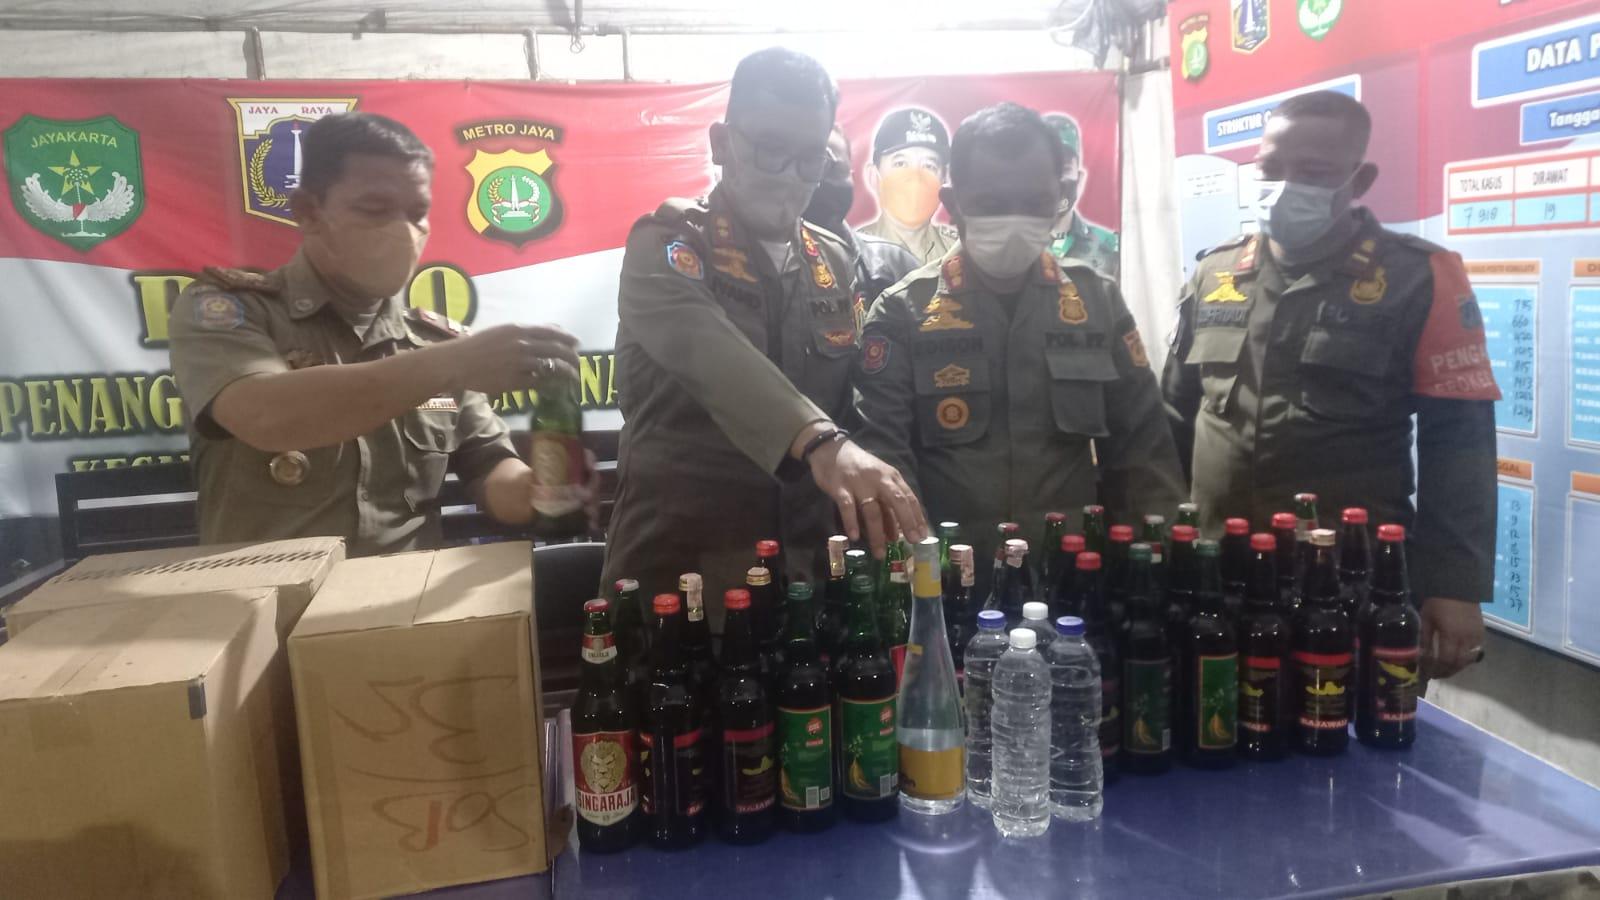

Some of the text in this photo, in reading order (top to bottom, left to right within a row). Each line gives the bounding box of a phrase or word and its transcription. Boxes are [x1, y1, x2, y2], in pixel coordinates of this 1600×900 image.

[1526, 38, 1582, 73] DATA
[249, 106, 333, 115] JAYA RAYA
[463, 123, 555, 141] METRO JAYA
[1217, 113, 1263, 137] STRUKTUR
[31, 131, 118, 148] JAYAKARTA
[1460, 175, 1502, 192] TOTAL KASUS
[1533, 168, 1569, 186] DIRAWAT
